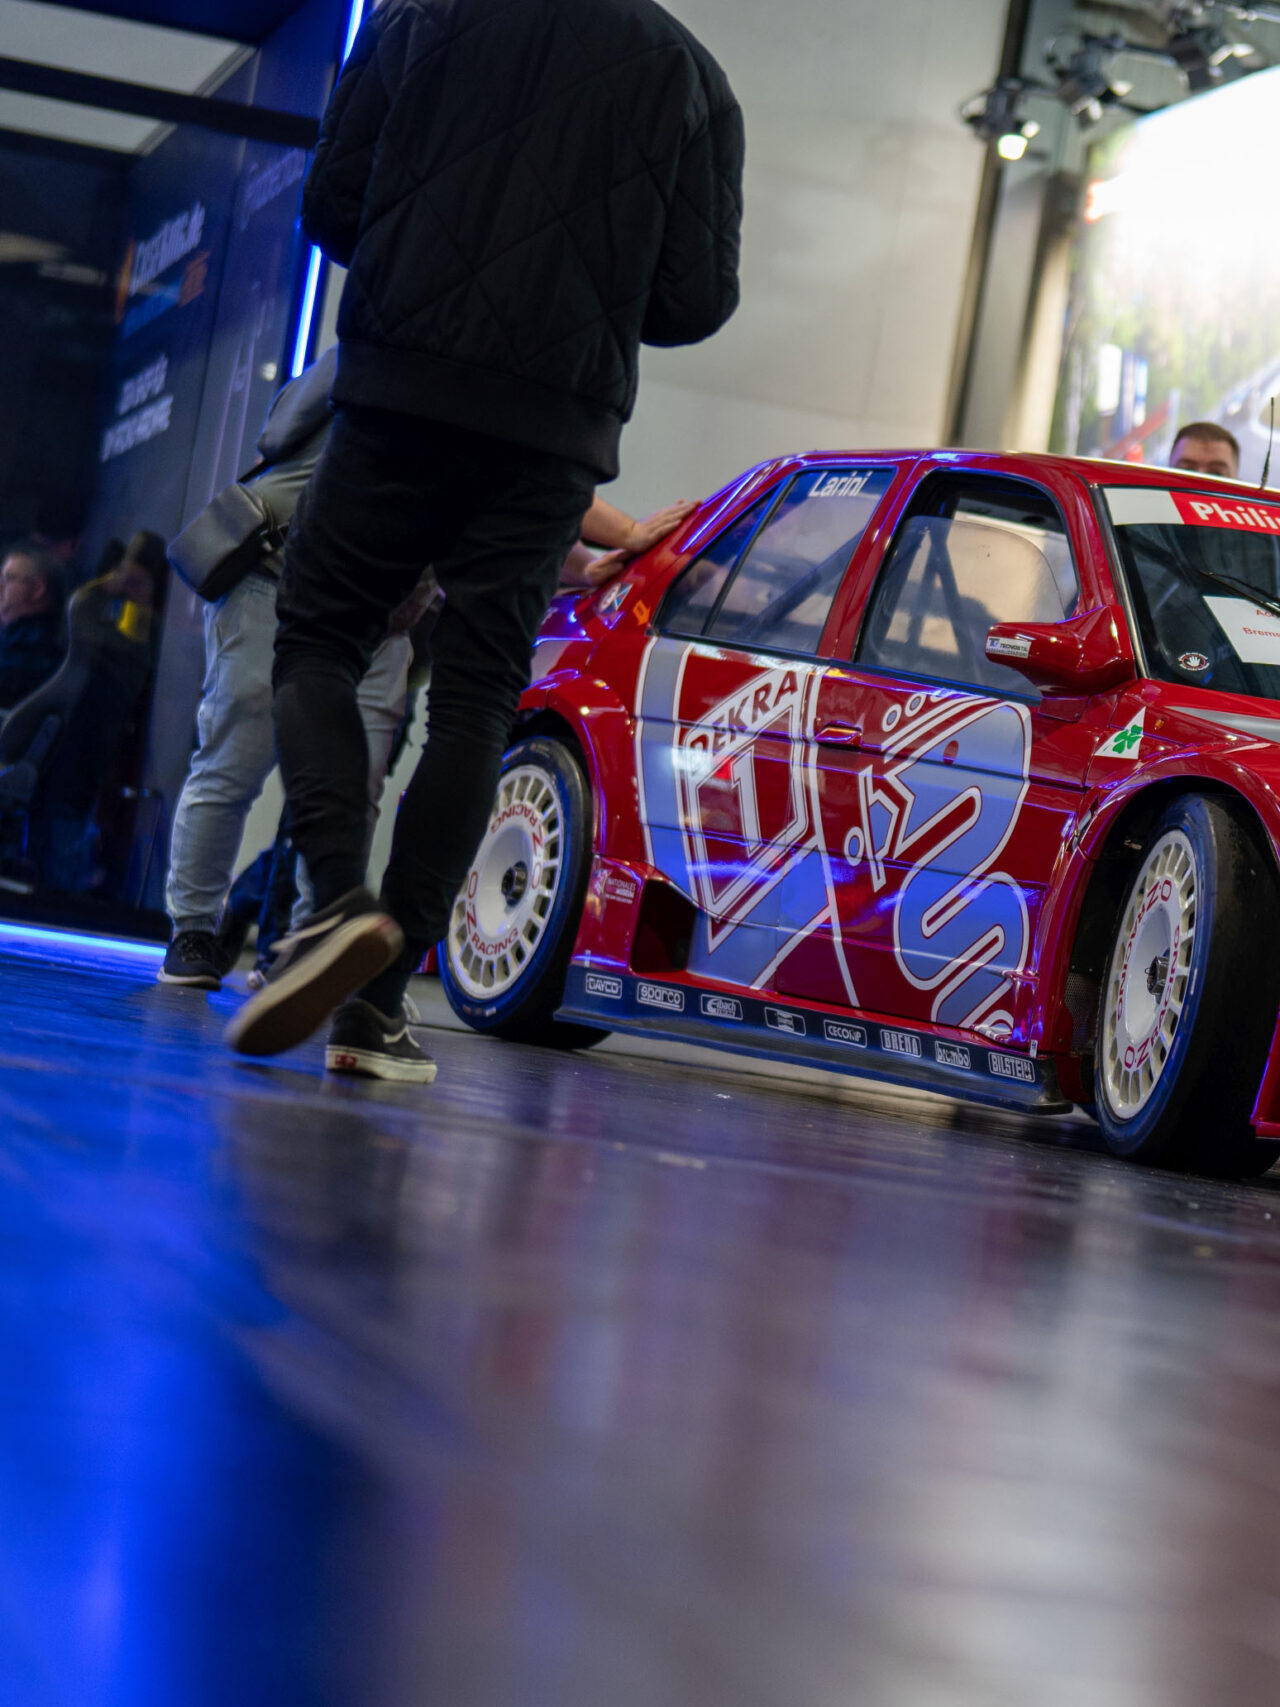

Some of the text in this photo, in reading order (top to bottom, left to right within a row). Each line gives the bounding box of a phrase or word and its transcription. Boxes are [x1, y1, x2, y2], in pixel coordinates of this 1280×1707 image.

[807, 470, 874, 497] Larini
[491, 803, 538, 833] RACING
[471, 927, 519, 956] RACING
[641, 985, 681, 1004] sparco
[991, 1053, 1033, 1080] BILSTEIN
